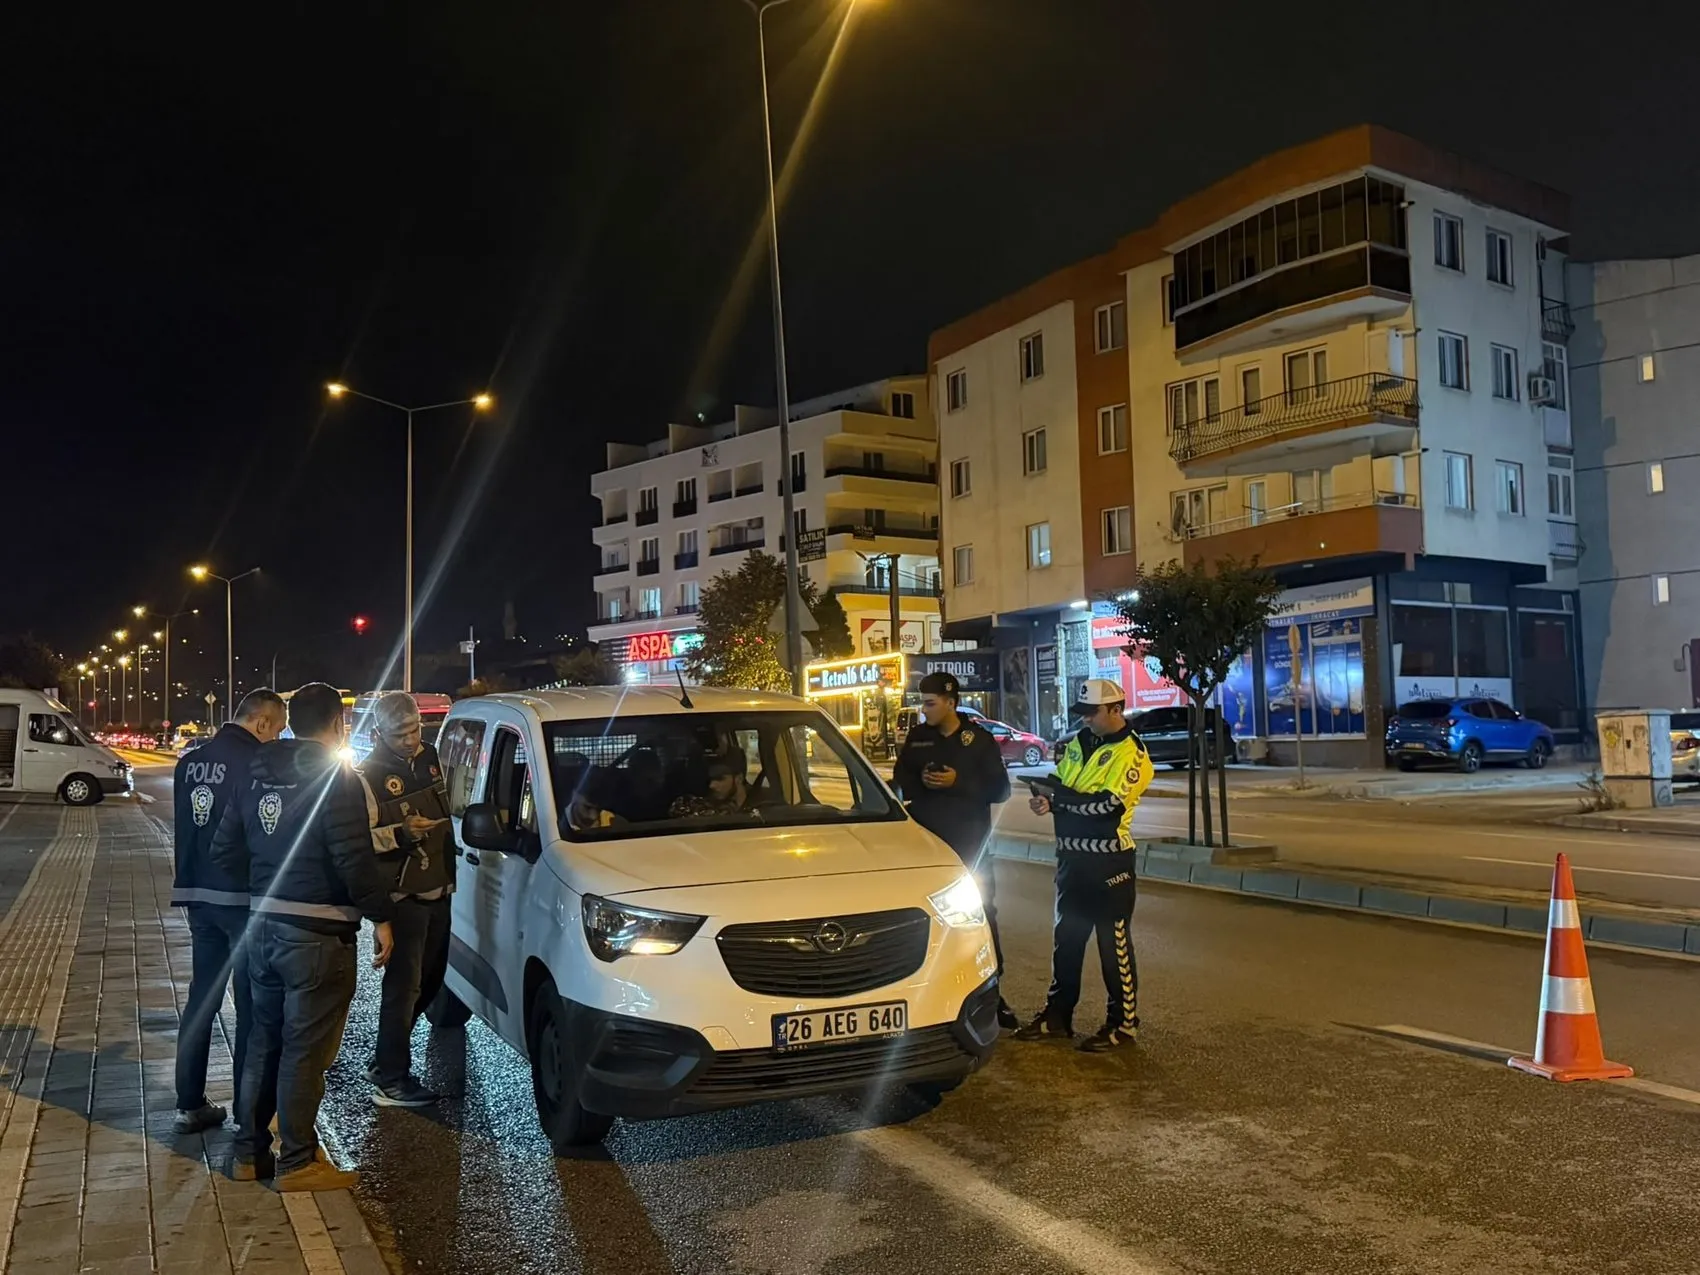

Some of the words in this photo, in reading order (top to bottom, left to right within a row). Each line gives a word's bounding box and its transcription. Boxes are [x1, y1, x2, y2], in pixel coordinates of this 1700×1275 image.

[799, 529, 825, 543] SATILIK
[628, 633, 672, 662] ASPA
[822, 665, 857, 688] Retro16
[927, 661, 975, 676] RETRO16
[788, 1017, 812, 1042] 26
[823, 1011, 857, 1037] AEG
[869, 1007, 903, 1032] 640
